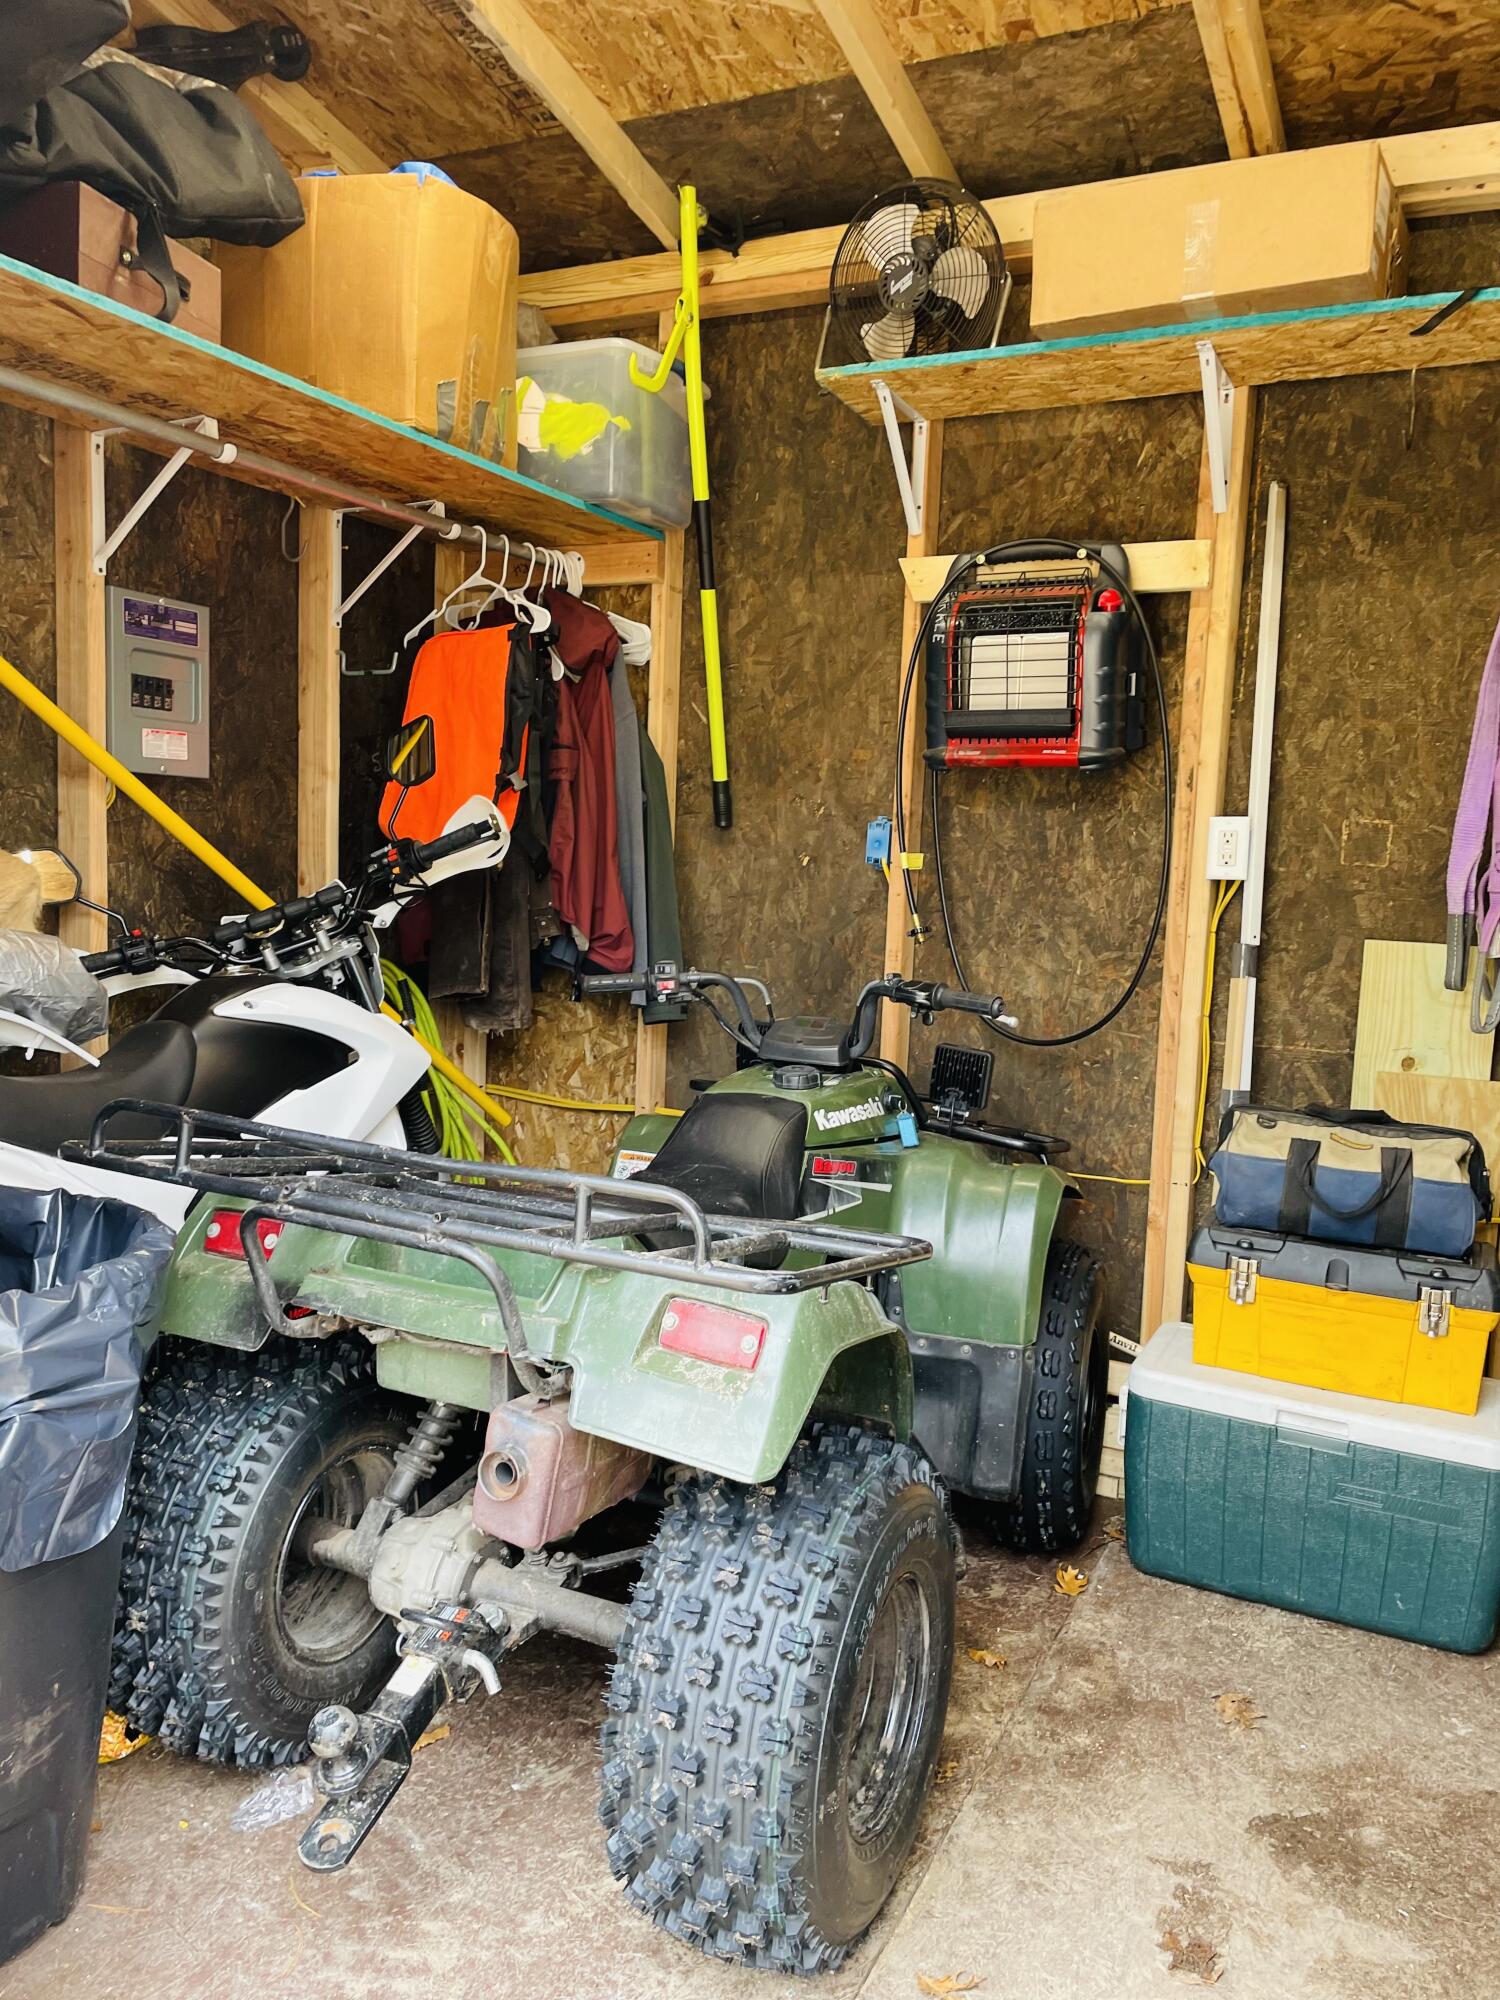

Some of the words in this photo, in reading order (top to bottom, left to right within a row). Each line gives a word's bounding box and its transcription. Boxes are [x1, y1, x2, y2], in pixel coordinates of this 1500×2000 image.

[814, 1097, 885, 1131] Kawasaki
[813, 1157, 857, 1176] Bayou
[1110, 1335, 1138, 1352] Anvil
